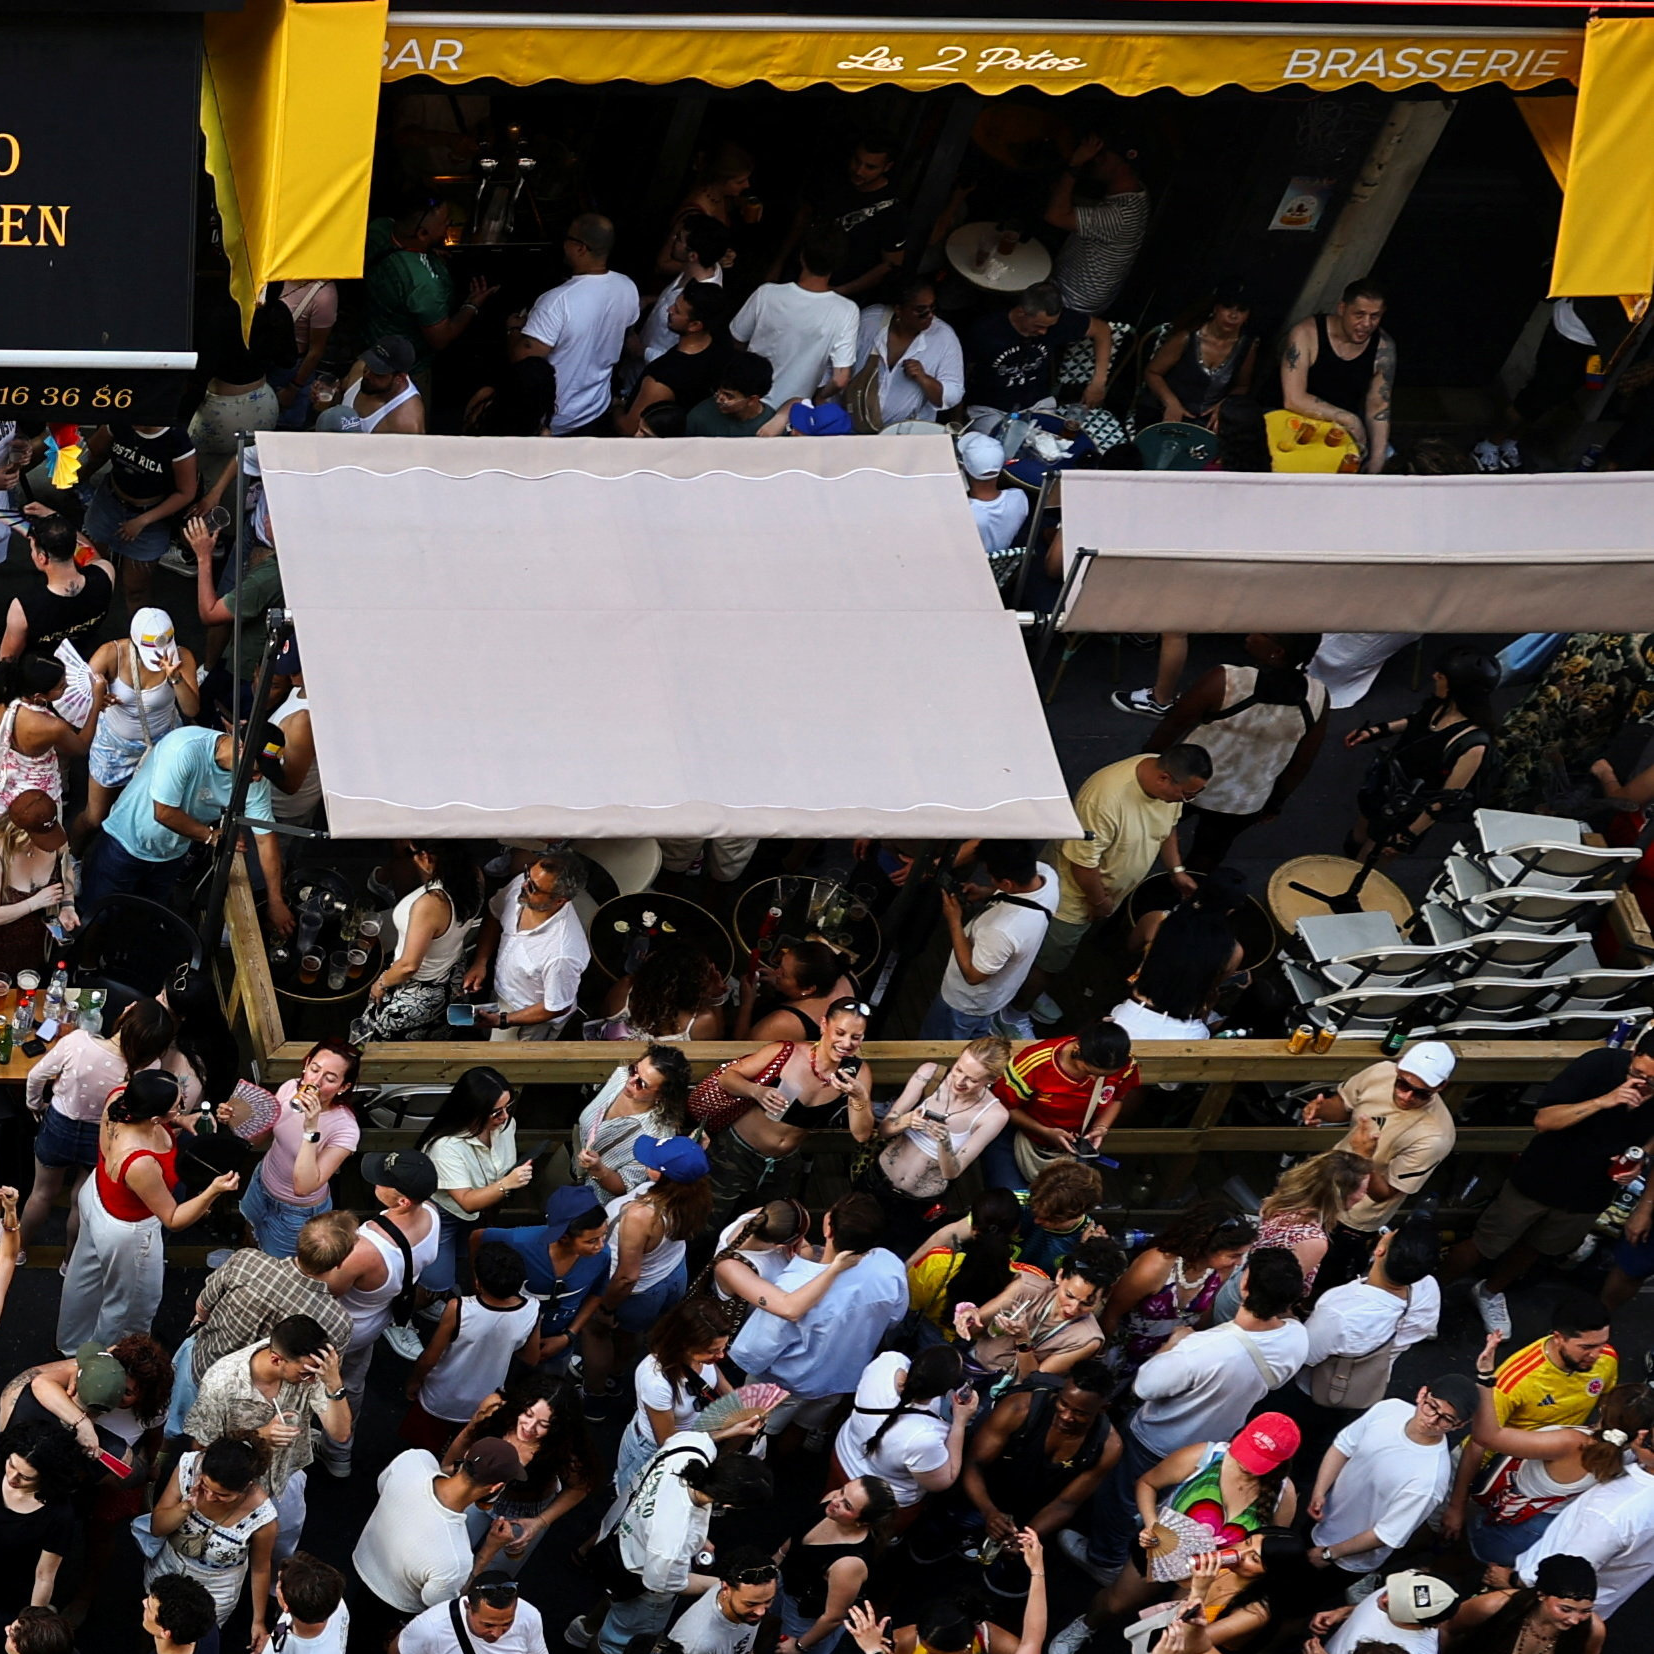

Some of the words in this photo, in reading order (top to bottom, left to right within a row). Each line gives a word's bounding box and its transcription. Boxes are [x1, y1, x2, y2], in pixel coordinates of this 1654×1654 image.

[837, 46, 905, 73] Les
[916, 47, 967, 72] 2
[977, 48, 1089, 74] Potos
[1282, 47, 1569, 80] BRASSERIE
[40, 386, 81, 408] 36
[91, 382, 133, 409] 86
